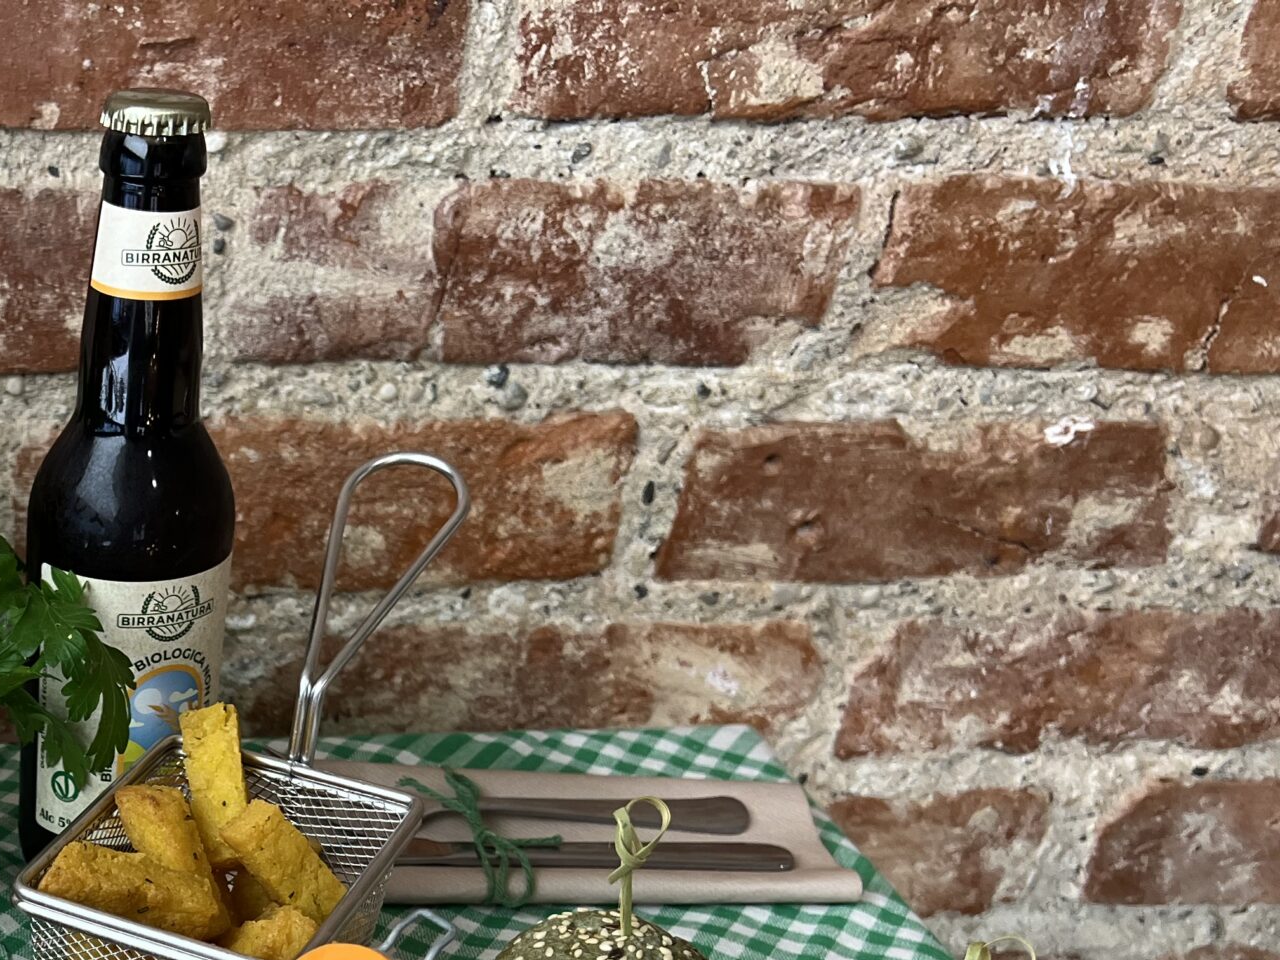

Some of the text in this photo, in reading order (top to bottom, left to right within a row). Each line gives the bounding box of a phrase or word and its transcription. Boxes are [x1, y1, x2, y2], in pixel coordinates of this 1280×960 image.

[124, 247, 202, 264] BIRRANATU
[121, 602, 212, 626] BIRRANATURA
[134, 648, 206, 672] BIOLOGICA
[39, 807, 55, 824] Alc
